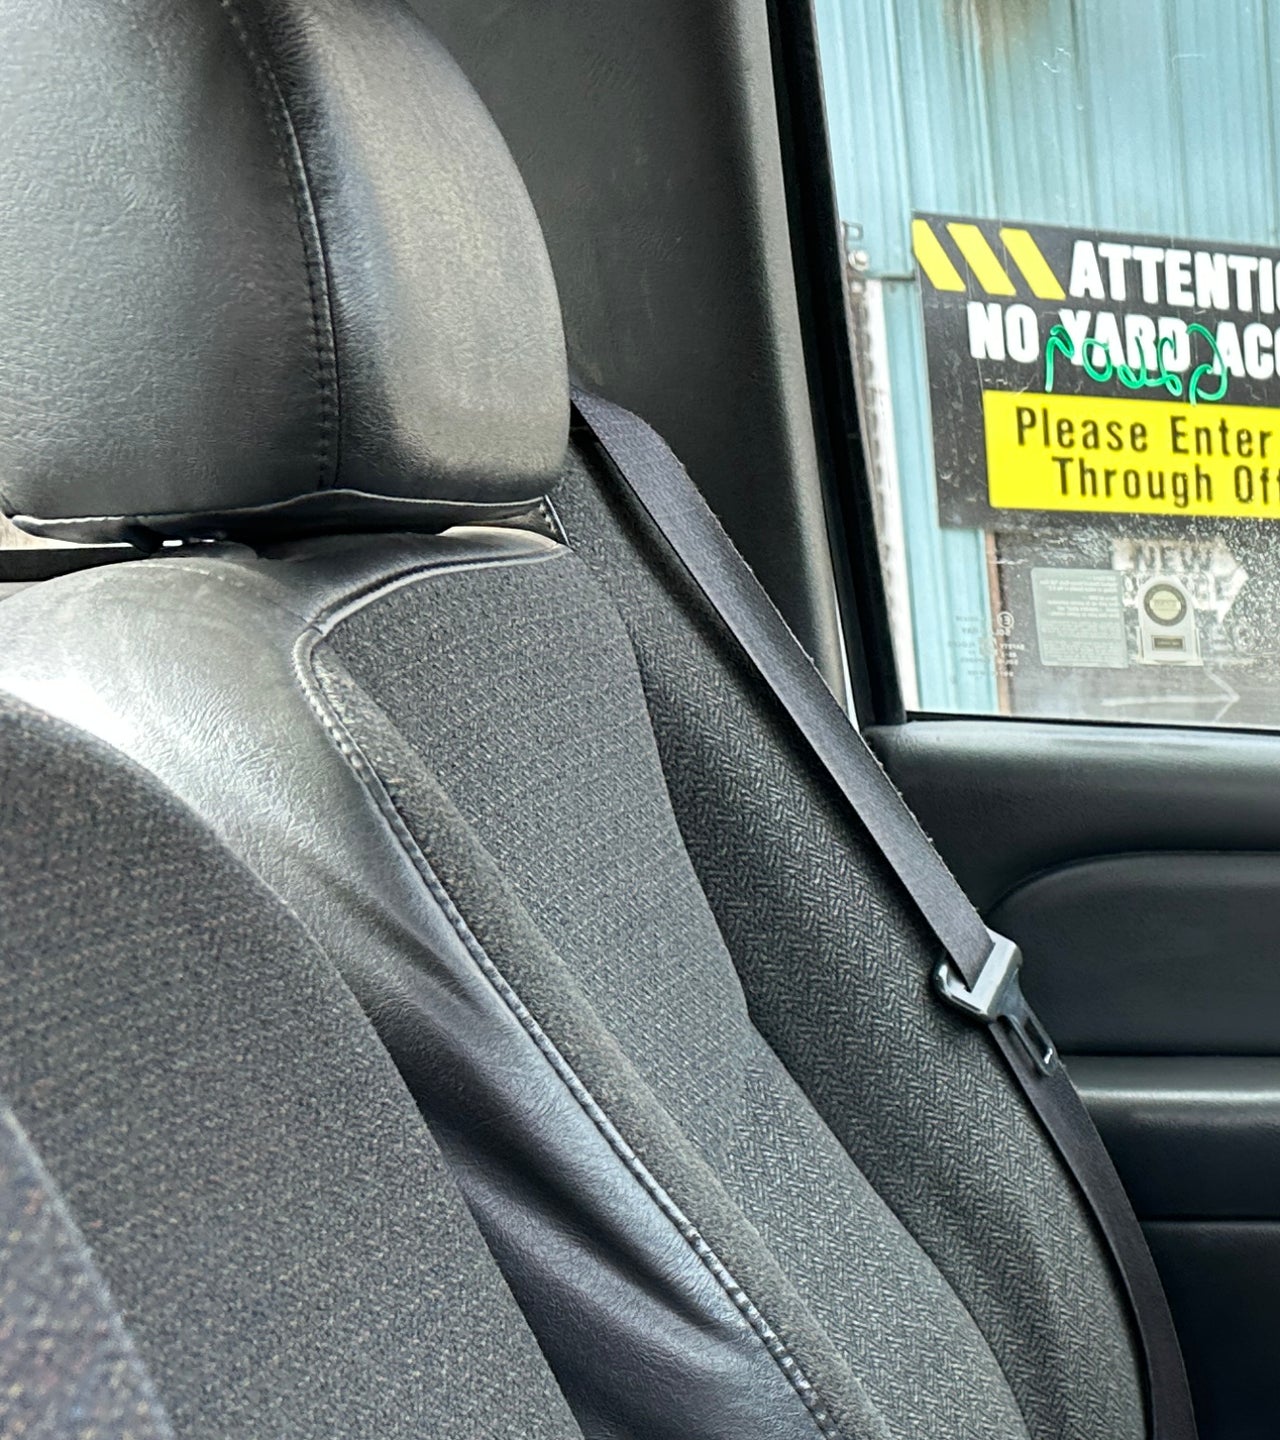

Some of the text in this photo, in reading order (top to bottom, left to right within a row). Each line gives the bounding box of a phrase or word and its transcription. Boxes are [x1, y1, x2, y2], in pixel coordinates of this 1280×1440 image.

[967, 301, 1039, 363] NO
[1059, 309, 1191, 374] YARD
[1015, 406, 1148, 452] Please
[1170, 414, 1273, 460] Enter
[1052, 456, 1212, 508] Through
